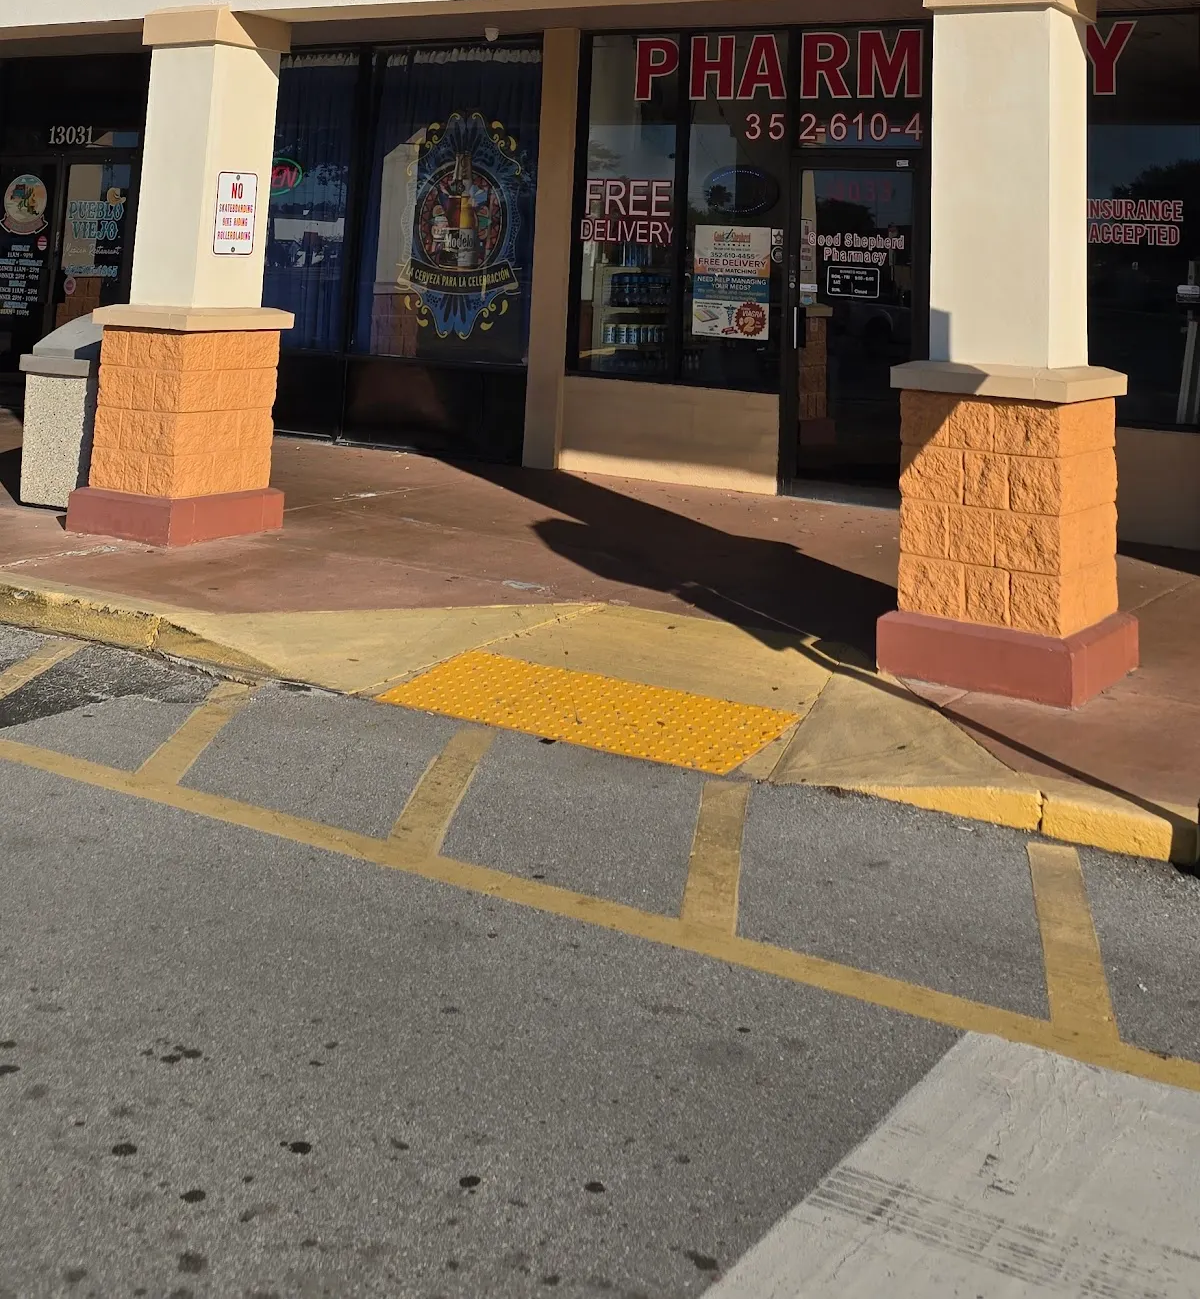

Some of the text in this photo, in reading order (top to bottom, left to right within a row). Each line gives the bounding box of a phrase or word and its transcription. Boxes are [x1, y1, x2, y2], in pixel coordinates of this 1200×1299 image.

[48, 126, 93, 145] 13031
[745, 112, 923, 141] 352-610-4
[231, 182, 244, 200] NO
[585, 179, 673, 217] FREE
[68, 200, 125, 221] PUEBLO
[219, 203, 254, 214] SKATEBOARDING
[1087, 199, 1184, 222] NSURANCE
[71, 219, 119, 240] VIEJO
[580, 219, 674, 244] DELIVERY
[1088, 223, 1181, 246] ACCEPTED
[808, 232, 842, 247] Good
[844, 233, 905, 252] Shepherd
[698, 257, 767, 268] FREE DELIVERY
[710, 251, 756, 260] 352-610-4455
[823, 247, 888, 266] Pharmacy
[415, 268, 441, 285] CERVEZA
[441, 275, 457, 287] PARA
[459, 276, 467, 288] LA
[731, 277, 767, 286] MANAGING
[742, 310, 763, 318] VIAGRA
